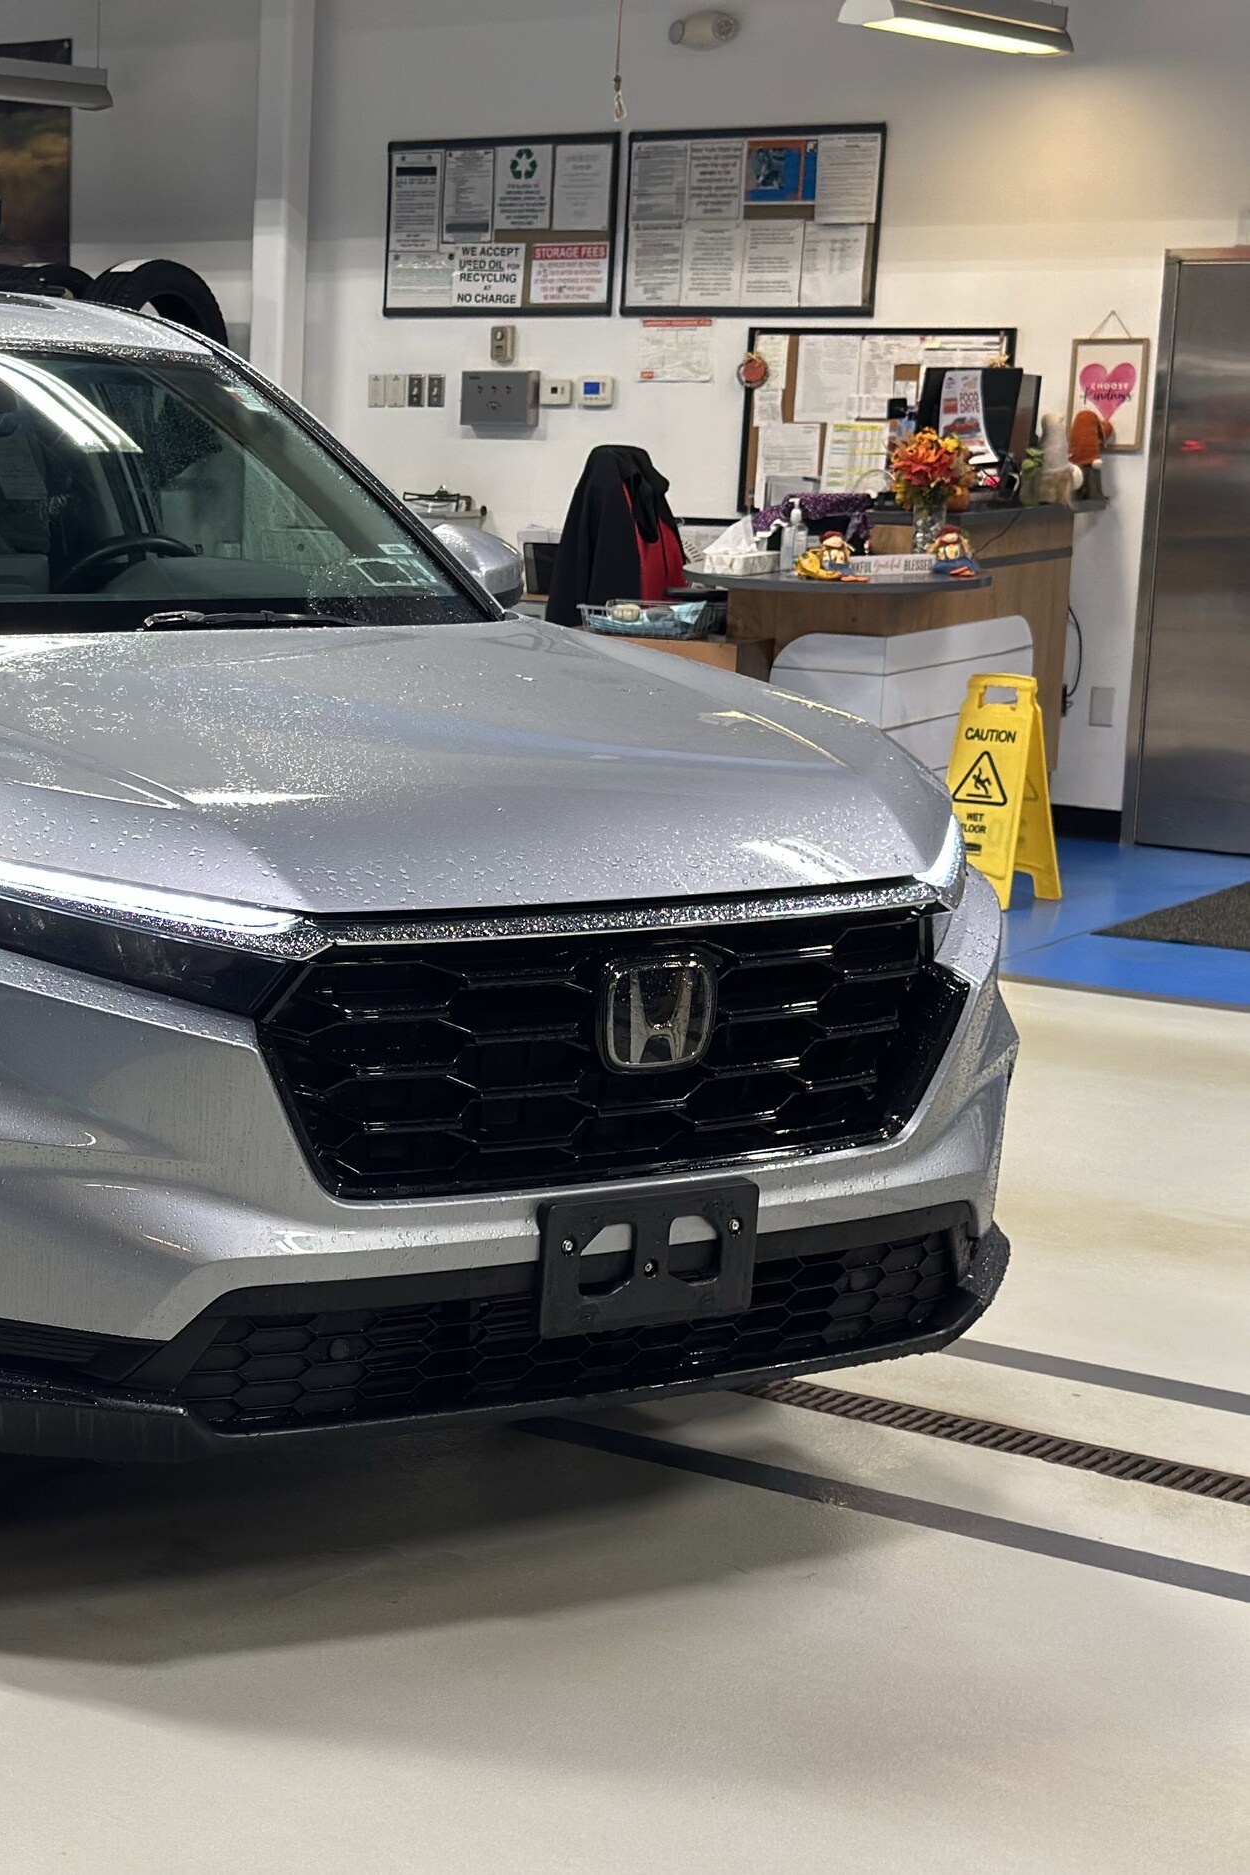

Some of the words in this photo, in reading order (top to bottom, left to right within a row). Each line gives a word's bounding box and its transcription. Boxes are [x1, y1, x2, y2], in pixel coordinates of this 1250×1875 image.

[462, 246, 477, 257] WE
[479, 247, 520, 257] ACCEPT
[535, 247, 579, 259] STORAGE
[581, 246, 606, 257] FEES
[459, 259, 485, 270] USED
[488, 260, 504, 271] OIL
[459, 273, 517, 284] RECYCLING
[457, 293, 472, 303] NO
[475, 293, 517, 304] CHARGE
[1090, 382, 1129, 390] CHOOSE
[960, 392, 979, 401] FOOD
[960, 403, 980, 413] DRIVE
[904, 559, 933, 572] BLESSED
[965, 727, 1016, 743] CAUTION
[966, 812, 984, 822] WET
